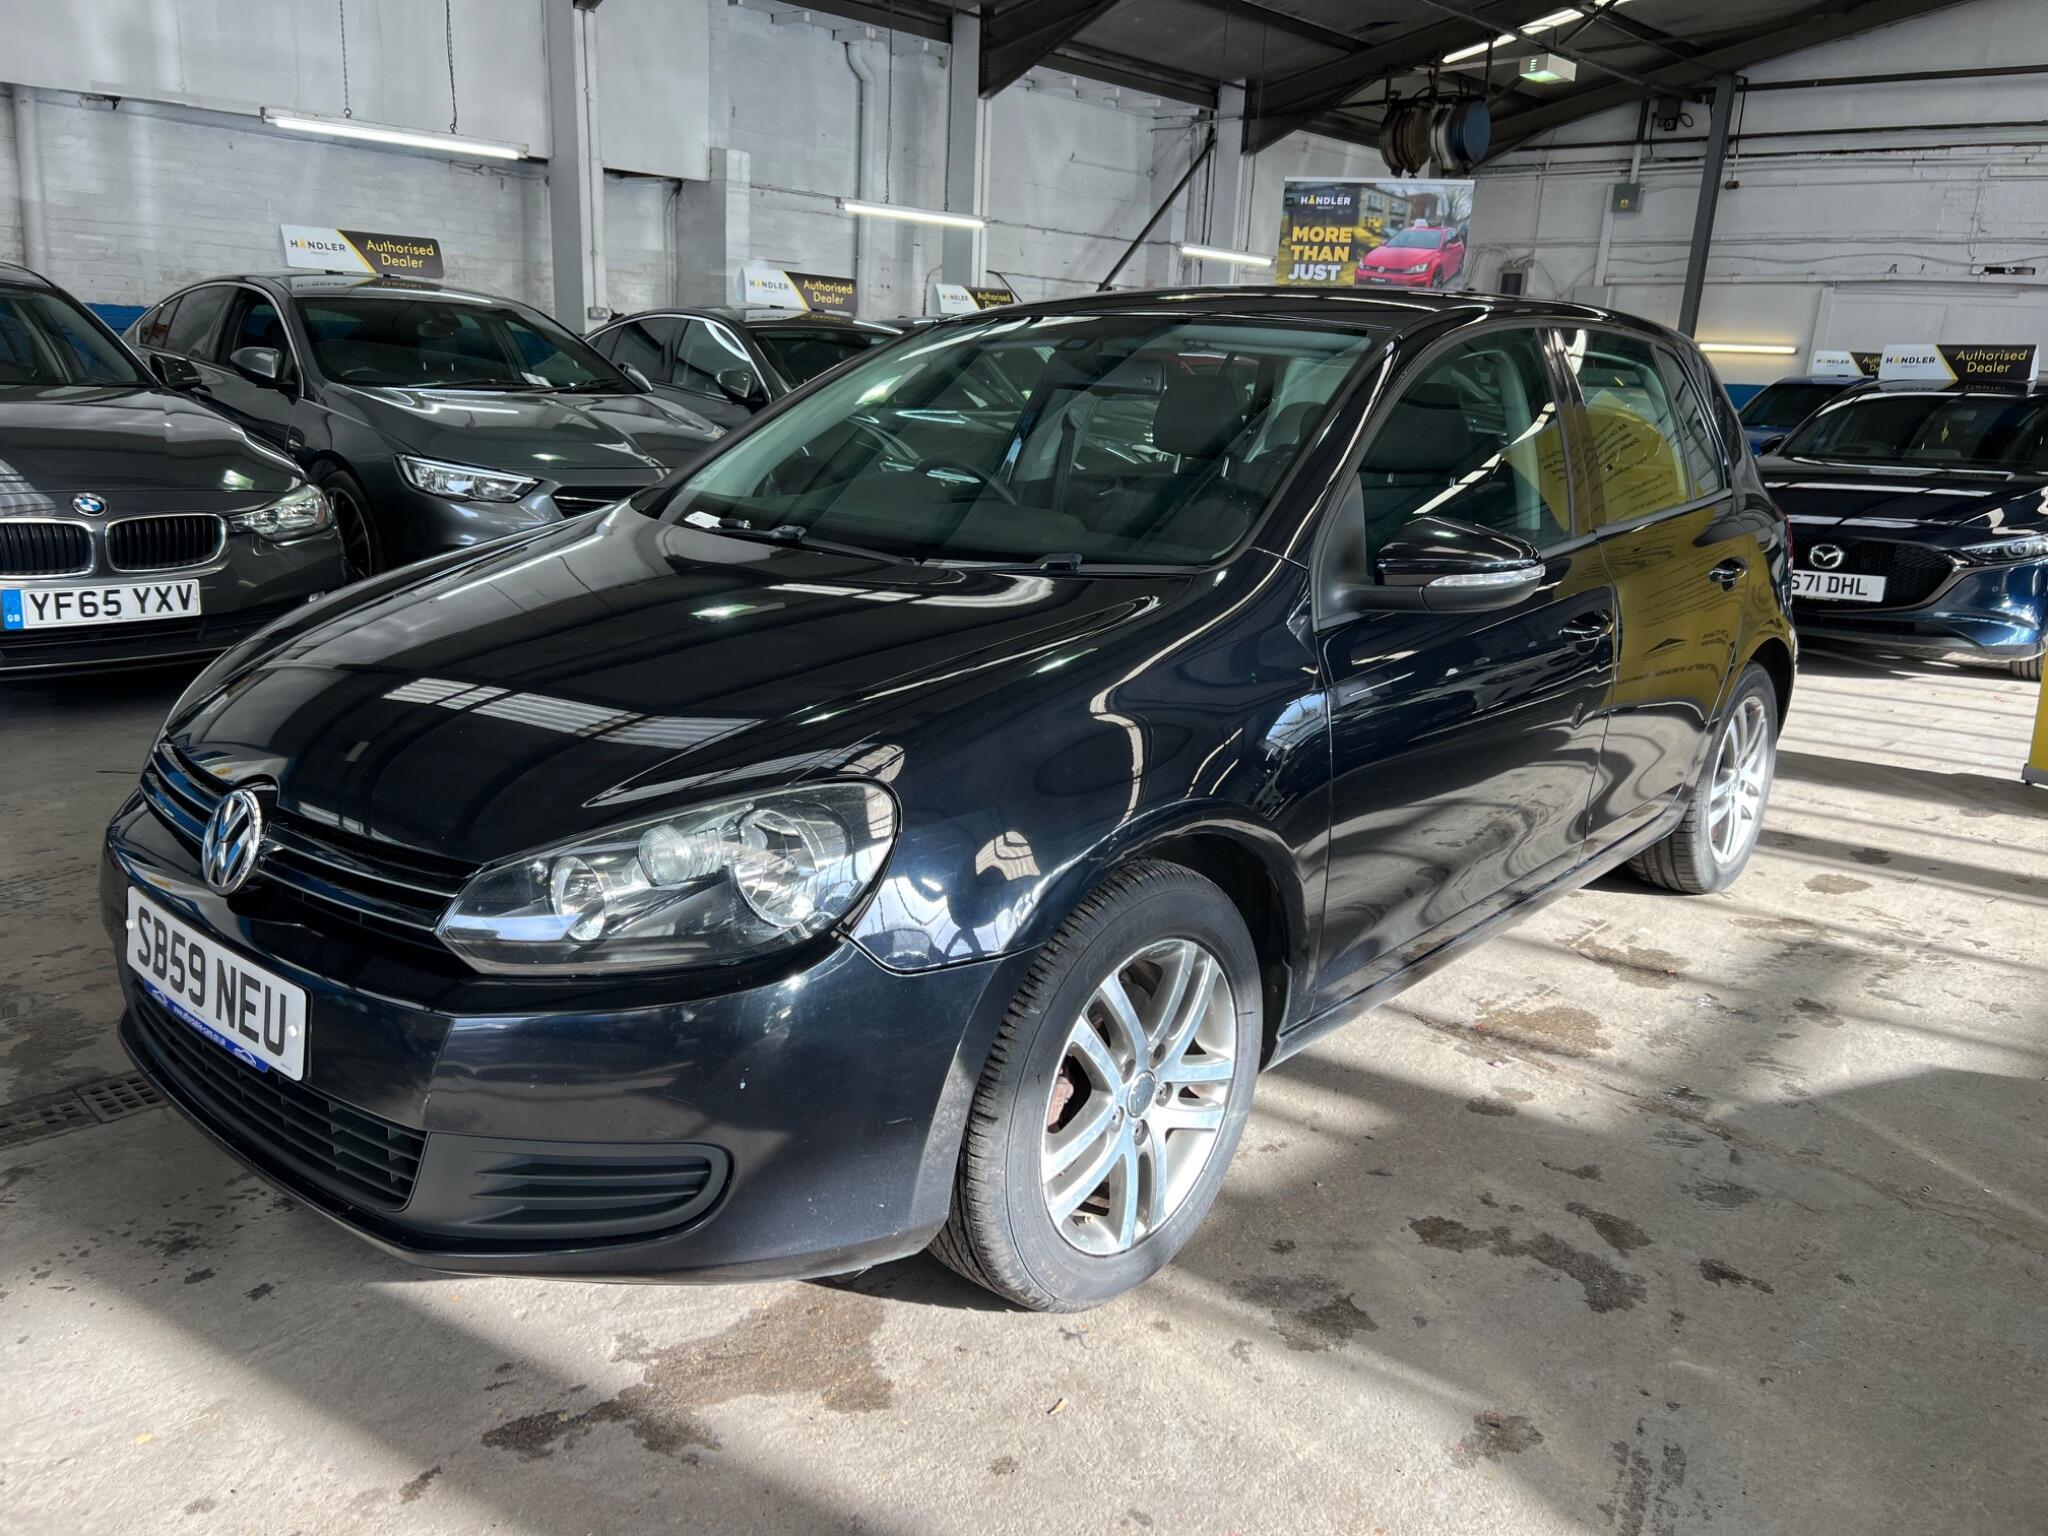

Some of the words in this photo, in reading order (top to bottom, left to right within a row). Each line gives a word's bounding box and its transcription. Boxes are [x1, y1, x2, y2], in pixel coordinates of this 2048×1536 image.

[1292, 226, 1352, 243] MORE
[367, 239, 435, 256] Authorised
[1290, 245, 1350, 262] THAN
[381, 254, 424, 268] Dealer
[1288, 263, 1341, 281] JUST
[803, 279, 853, 294] Authorised
[813, 291, 845, 304] Dealer
[1956, 349, 2027, 361] Authorised
[1966, 361, 2011, 373] Dealer
[1826, 575, 1868, 596] DHL
[29, 589, 122, 621] YF65
[132, 584, 193, 614] YXV
[7, 614, 20, 623] GB
[137, 906, 206, 1008] SB59
[215, 958, 287, 1057] NEU
